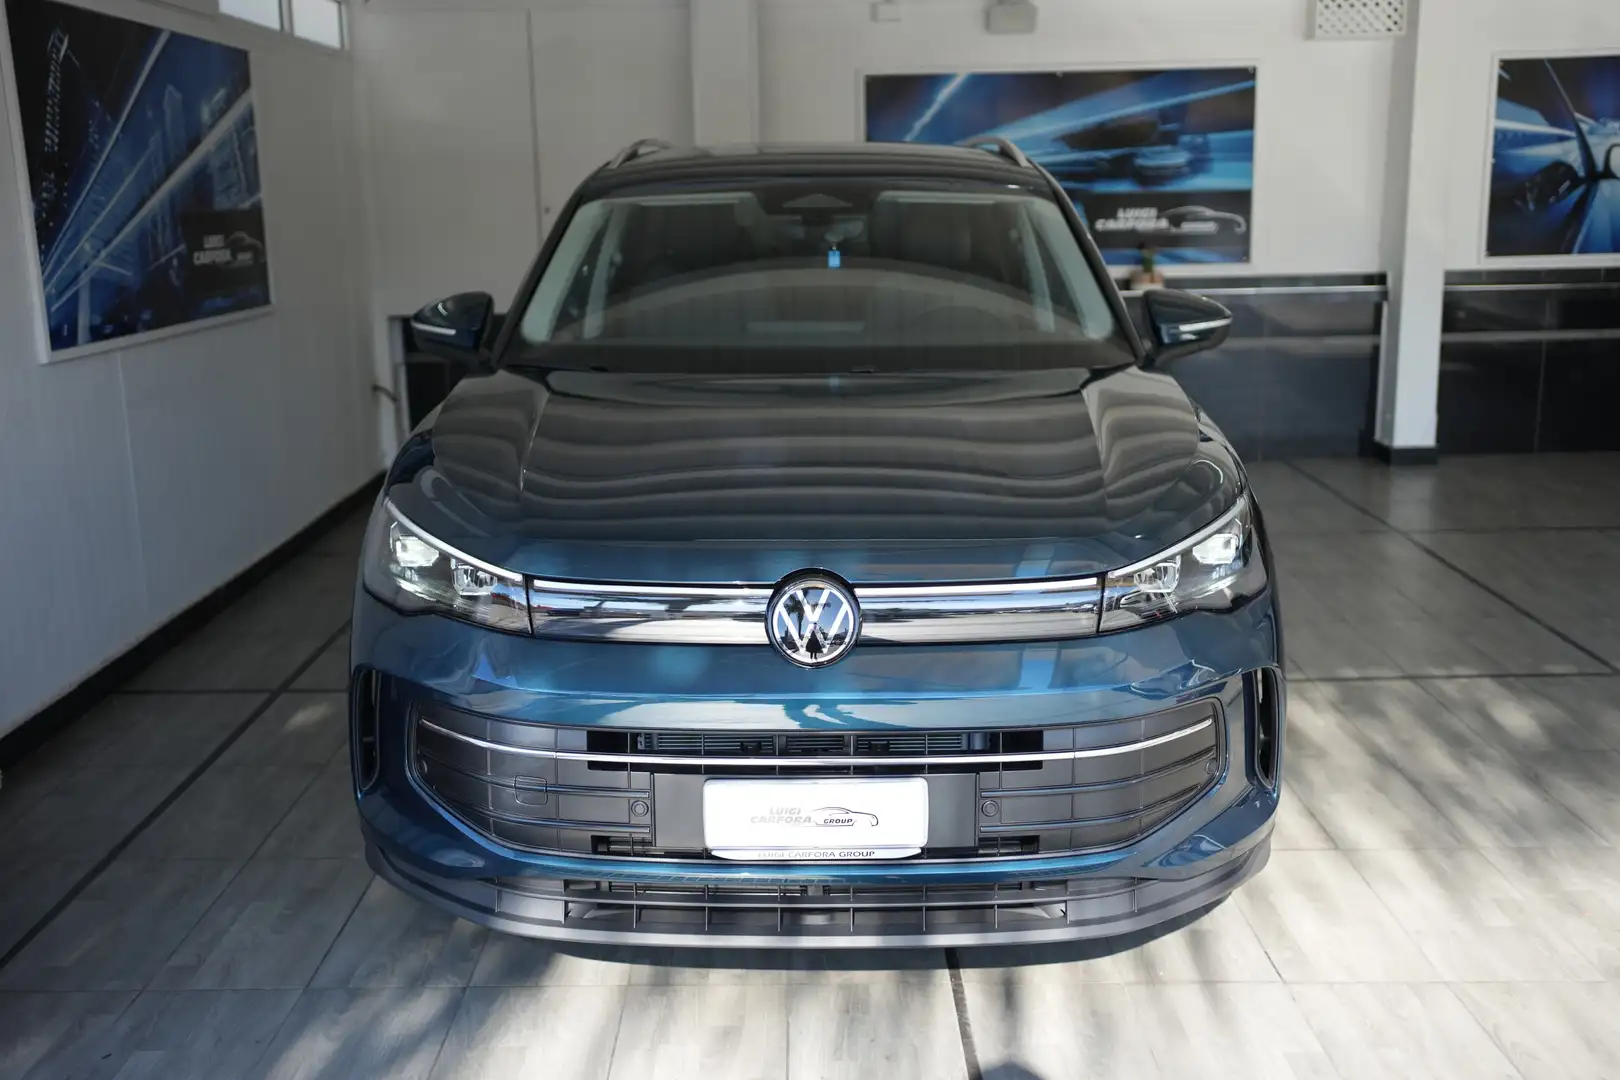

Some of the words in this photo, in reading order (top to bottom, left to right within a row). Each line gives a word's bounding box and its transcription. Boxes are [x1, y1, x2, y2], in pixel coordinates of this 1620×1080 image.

[776, 586, 850, 656] VW
[769, 807, 802, 815] LUIGI
[750, 816, 812, 824] CARFORA
